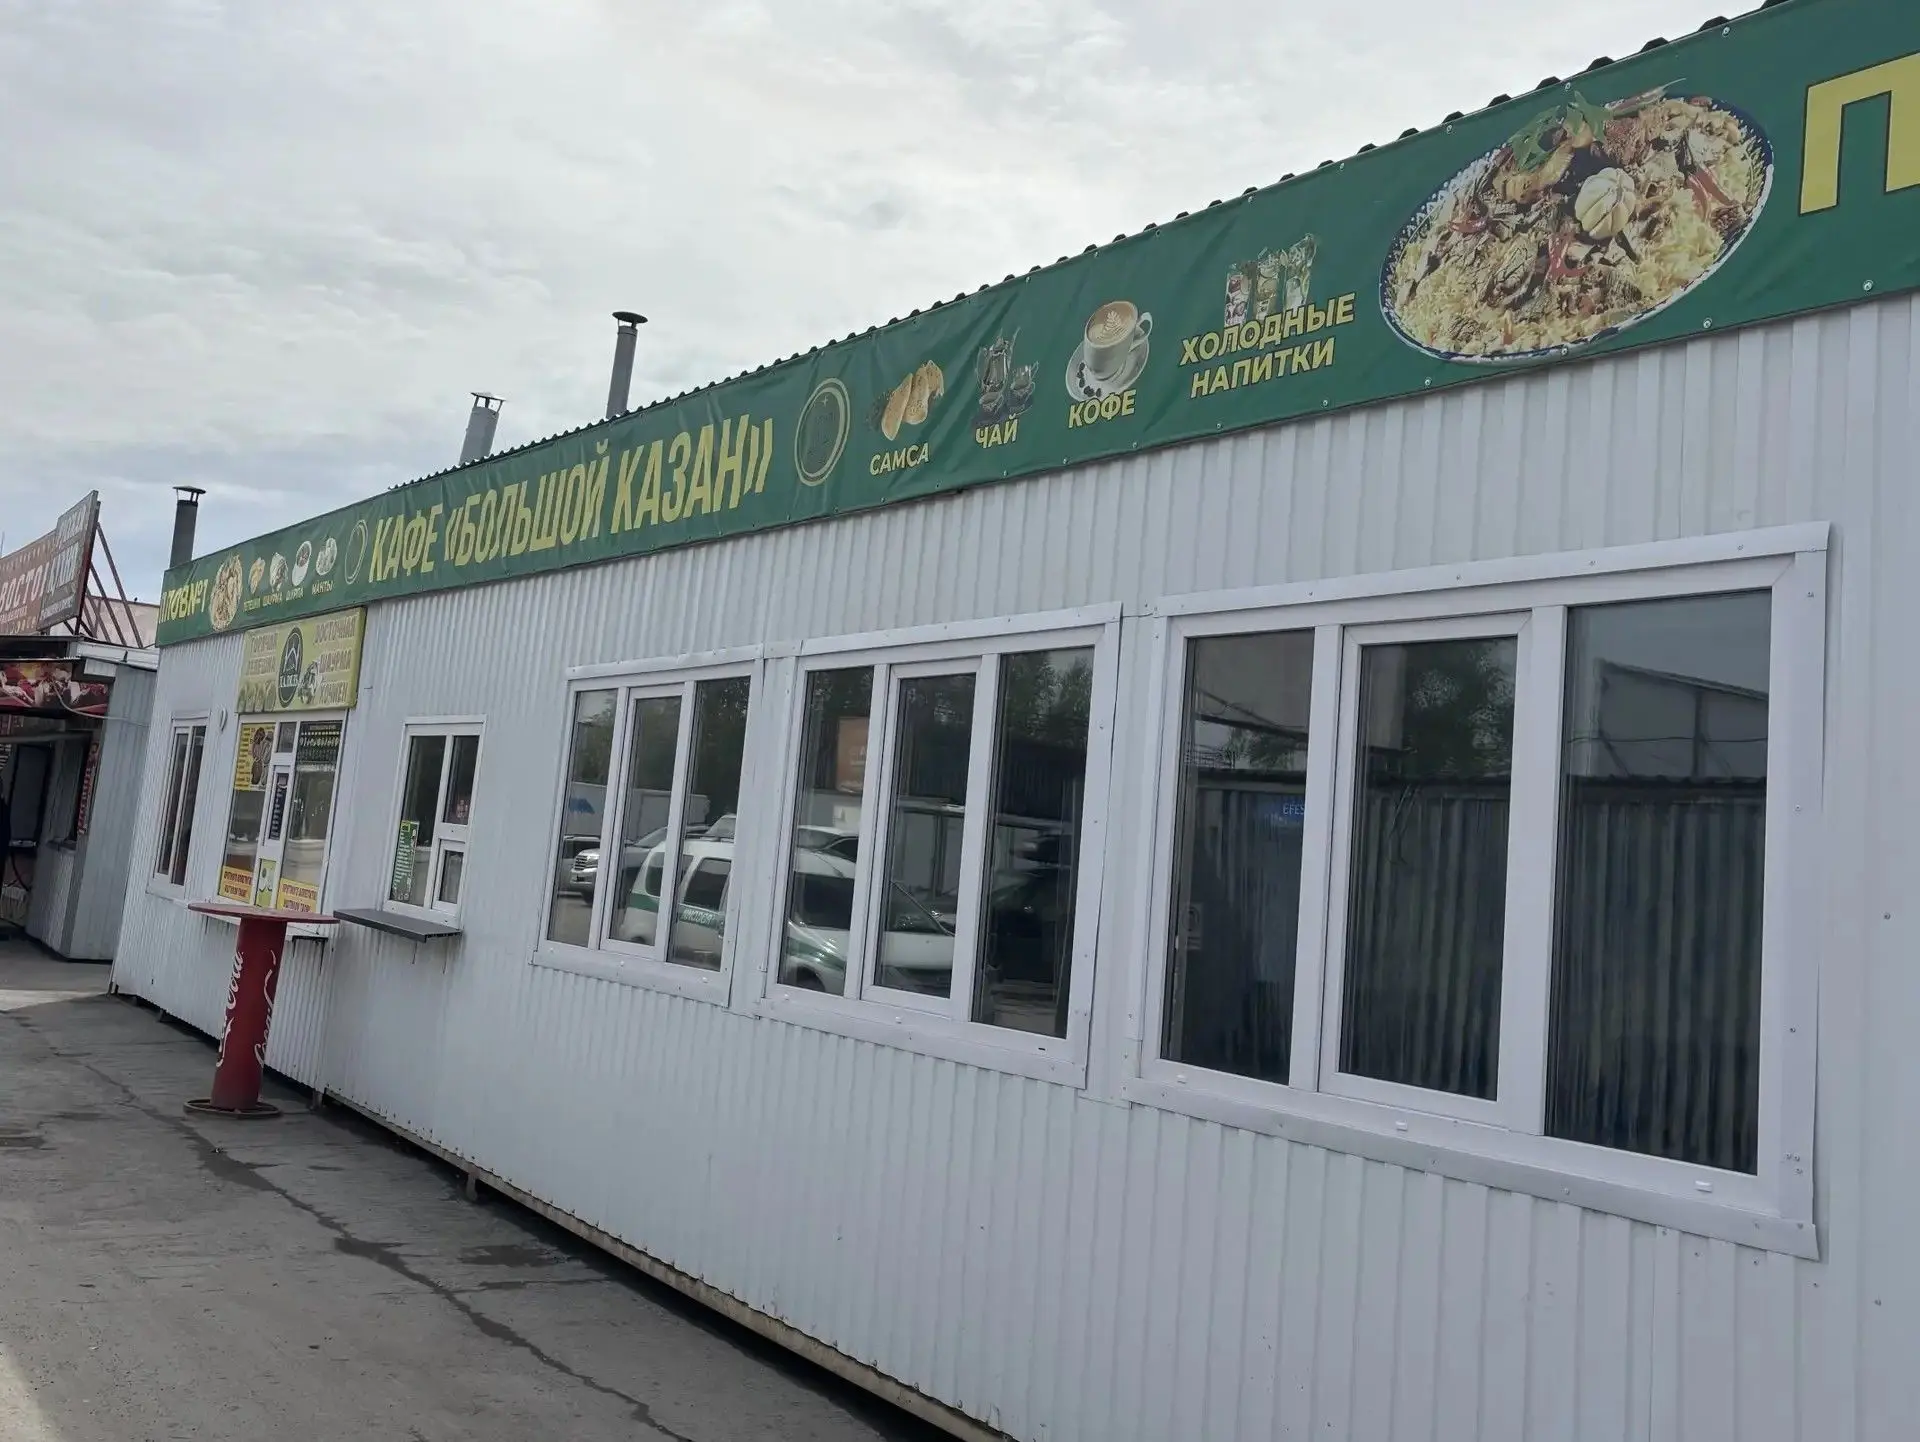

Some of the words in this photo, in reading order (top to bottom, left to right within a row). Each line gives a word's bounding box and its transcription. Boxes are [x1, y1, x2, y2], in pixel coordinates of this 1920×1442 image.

[1800, 52, 1920, 215] П
[1179, 292, 1356, 366] ХОЛОДНЫЕ
[1190, 336, 1335, 399] НАПИТКИ
[975, 414, 1019, 449] ЧАЙ
[1067, 389, 1137, 429] КОФЕ
[869, 442, 930, 476] САМСА
[369, 503, 443, 583] КАФЕ
[444, 439, 611, 567] «БОЛЬШОЙ
[610, 413, 774, 534] КАЗАН»
[311, 580, 335, 595] МАНТЫ
